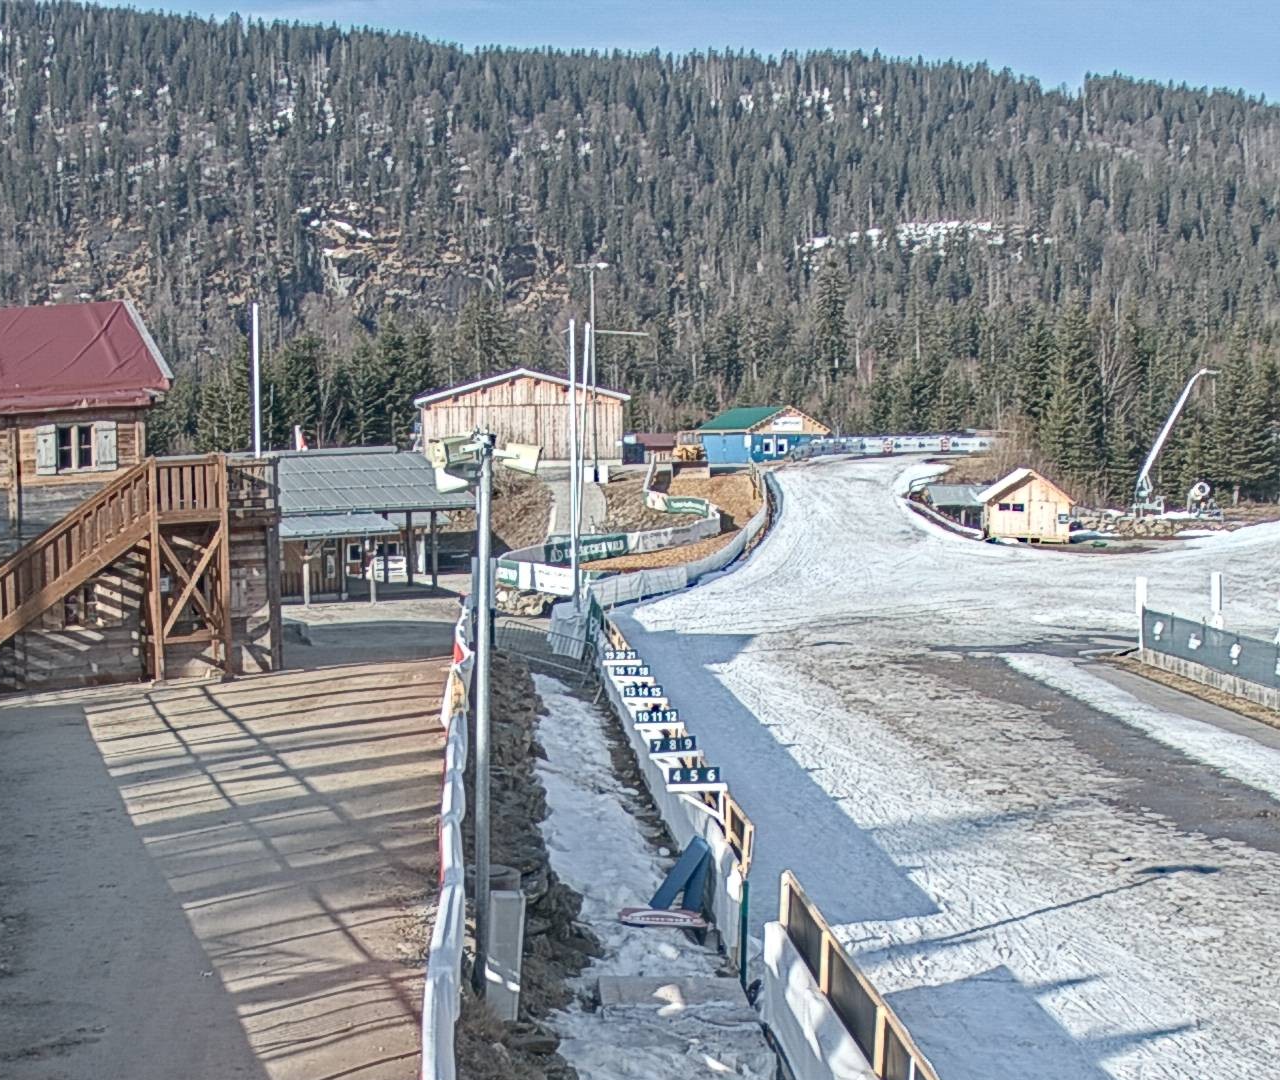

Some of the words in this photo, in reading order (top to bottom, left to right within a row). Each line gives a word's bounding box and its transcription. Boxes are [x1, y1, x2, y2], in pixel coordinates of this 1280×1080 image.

[626, 688, 636, 697] 13
[638, 688, 649, 697] 14
[651, 688, 662, 697] 15
[638, 712, 649, 722] 10
[651, 712, 663, 721] 11
[665, 711, 677, 721] 12
[653, 740, 662, 752] 7
[669, 739, 677, 750] 8
[684, 738, 693, 750] 9
[672, 769, 682, 782] 4
[690, 769, 699, 782] 5
[706, 769, 716, 782] 6
